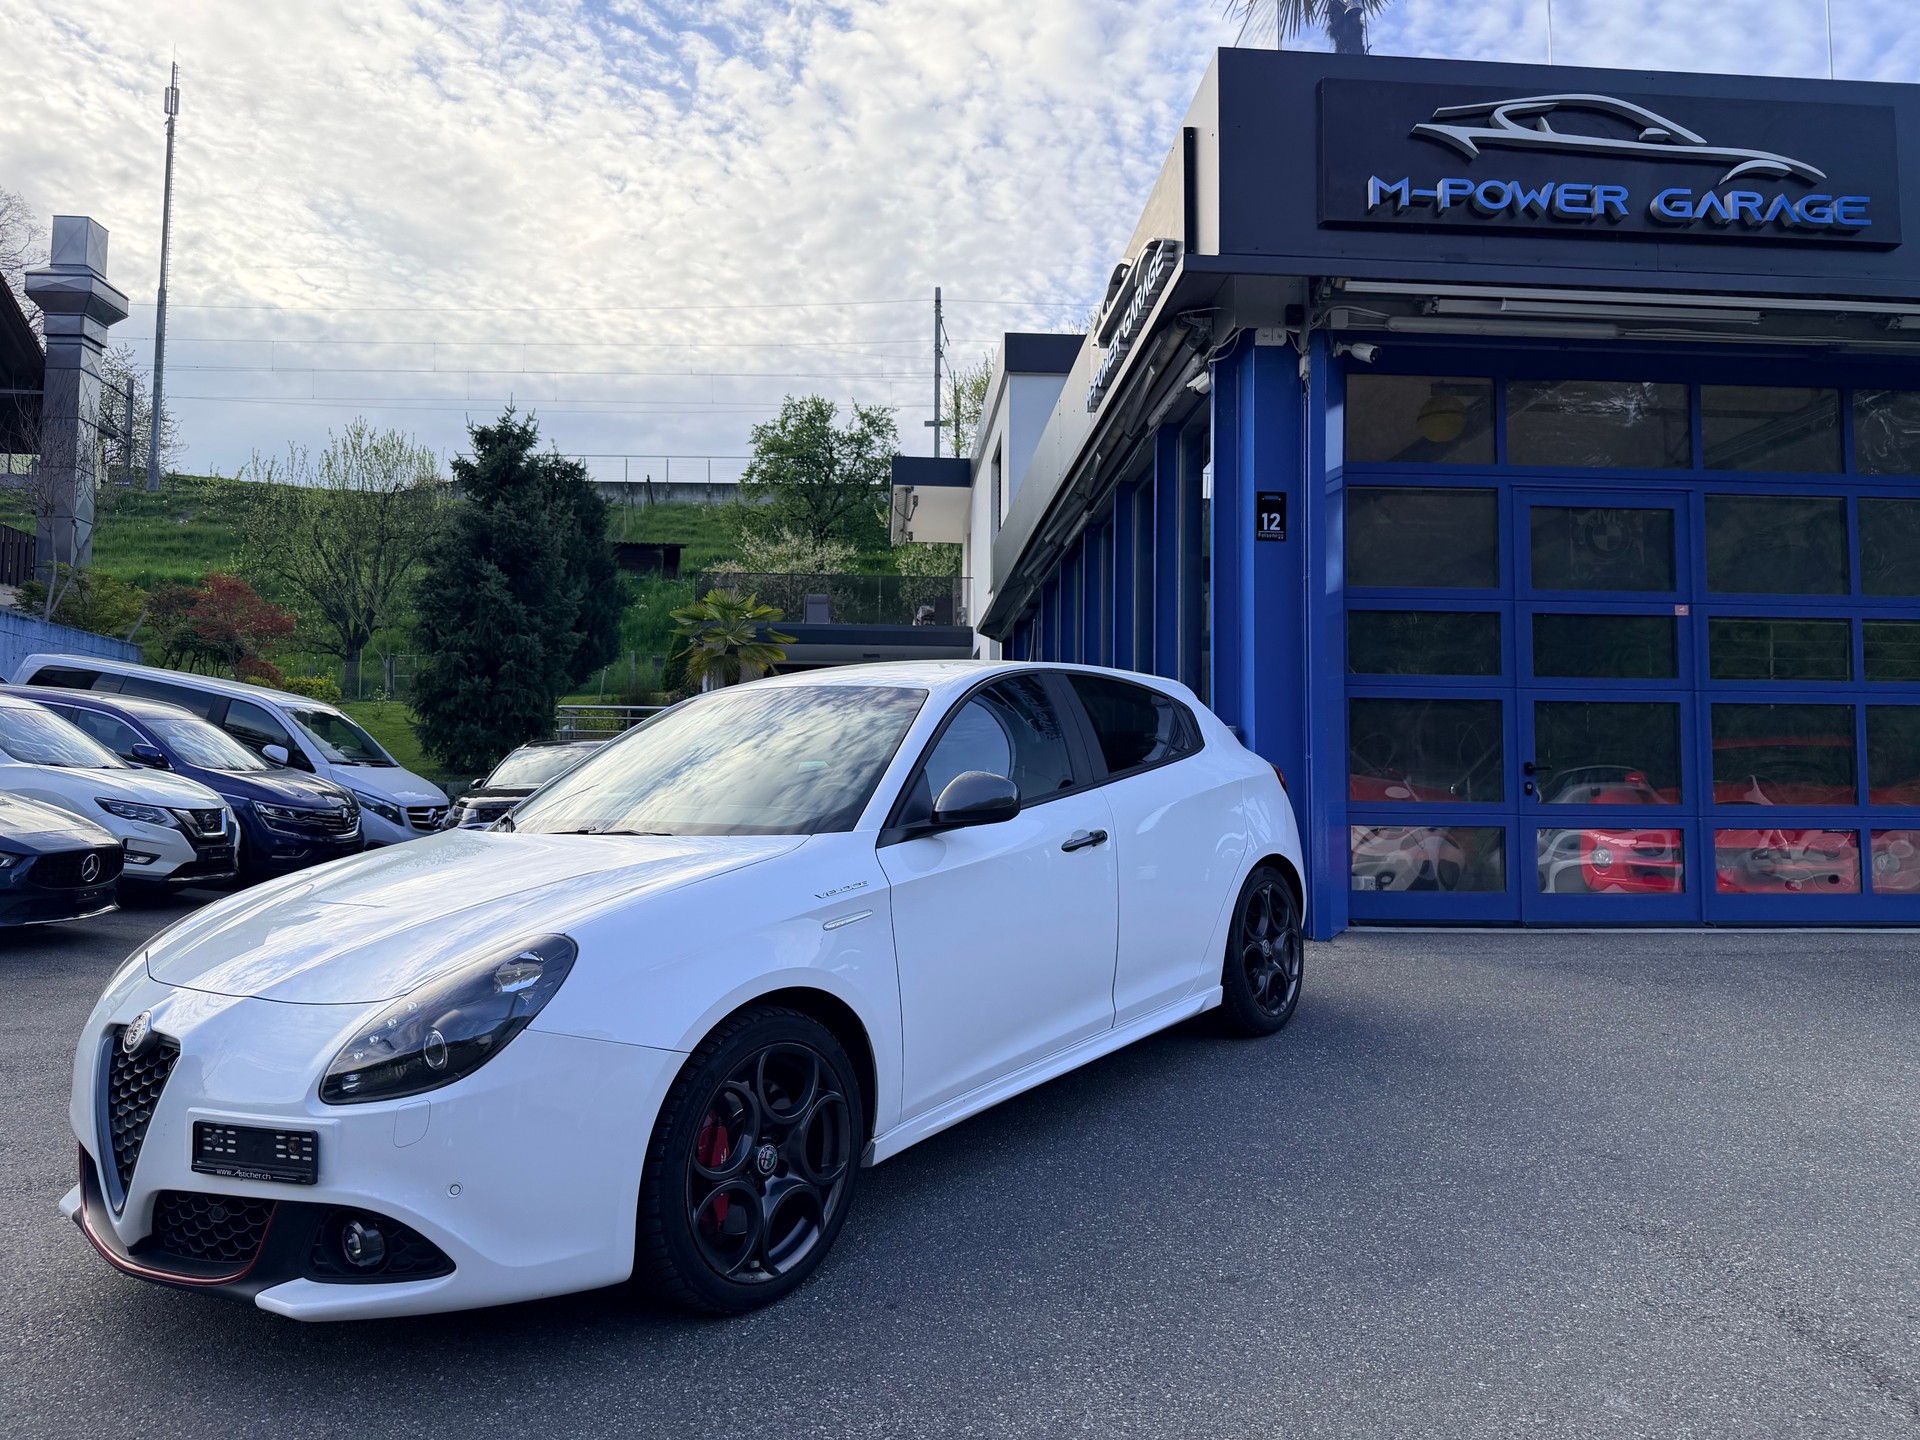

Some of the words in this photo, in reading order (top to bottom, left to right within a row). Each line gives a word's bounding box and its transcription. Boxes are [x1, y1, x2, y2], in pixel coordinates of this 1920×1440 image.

[1368, 175, 1630, 218] M-POWER
[1650, 188, 1872, 228] GARAGE
[1122, 239, 1166, 339] GARAGE
[1261, 513, 1281, 531] 12
